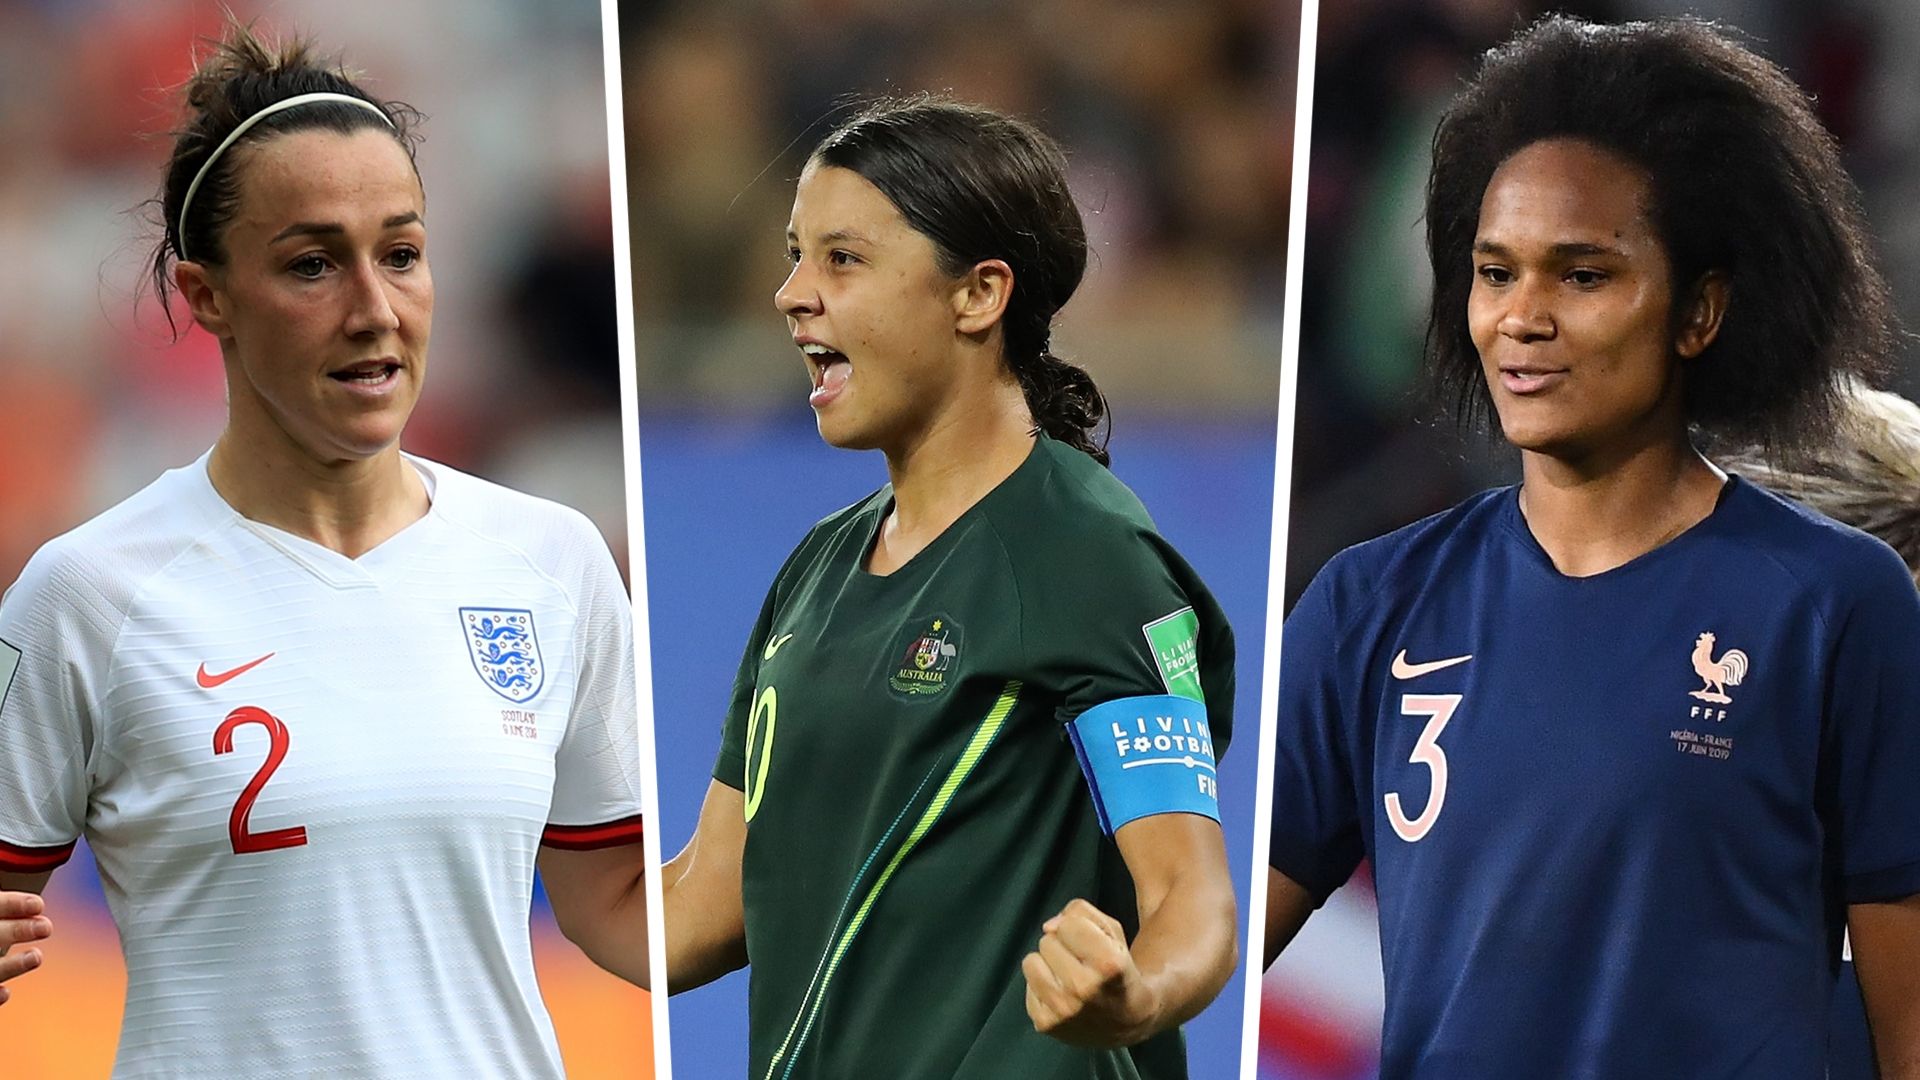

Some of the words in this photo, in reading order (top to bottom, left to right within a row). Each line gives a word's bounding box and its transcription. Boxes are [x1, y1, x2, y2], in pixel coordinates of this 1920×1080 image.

[897, 668, 943, 682] AUSTRALIA
[1112, 716, 1211, 738] LIVIN
[1677, 742, 1688, 753] 17
[1689, 744, 1708, 755] JUIN
[1708, 747, 1730, 760] 2019
[1384, 694, 1463, 843] 3
[212, 705, 309, 855] 2
